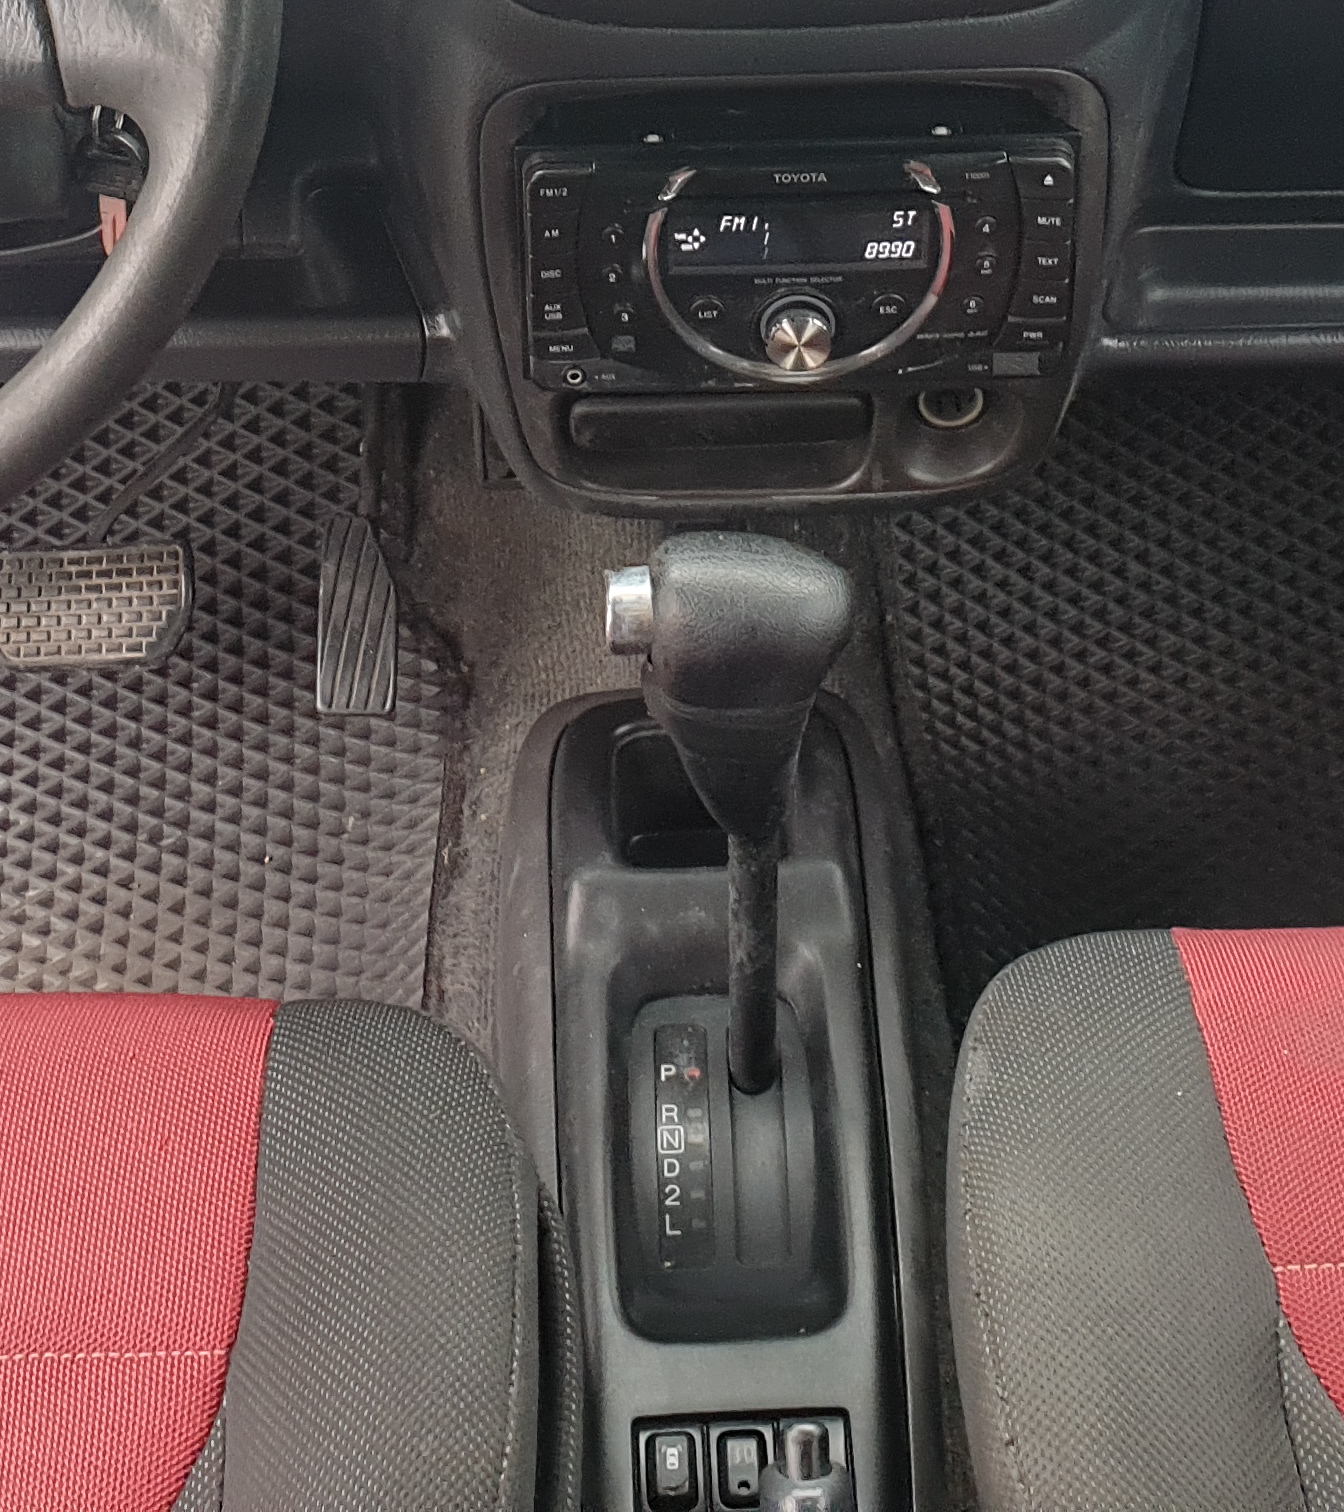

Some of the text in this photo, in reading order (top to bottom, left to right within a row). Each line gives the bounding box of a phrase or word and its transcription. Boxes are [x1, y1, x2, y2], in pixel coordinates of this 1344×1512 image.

[773, 172, 827, 184] TOYOTA
[892, 210, 917, 228] ST
[1037, 216, 1062, 226] MUTE
[544, 229, 559, 238] AM
[1037, 257, 1058, 265] TEXT
[1032, 295, 1057, 304] SCAN
[698, 310, 718, 319] LIST
[879, 305, 897, 314] ESC
[549, 345, 574, 353] MENU
[660, 1064, 677, 1082] P
[661, 1104, 678, 1123] R
[662, 1130, 679, 1149] N
[663, 1158, 680, 1178] D
[664, 1184, 681, 1206] 2
[665, 1213, 682, 1236] L
